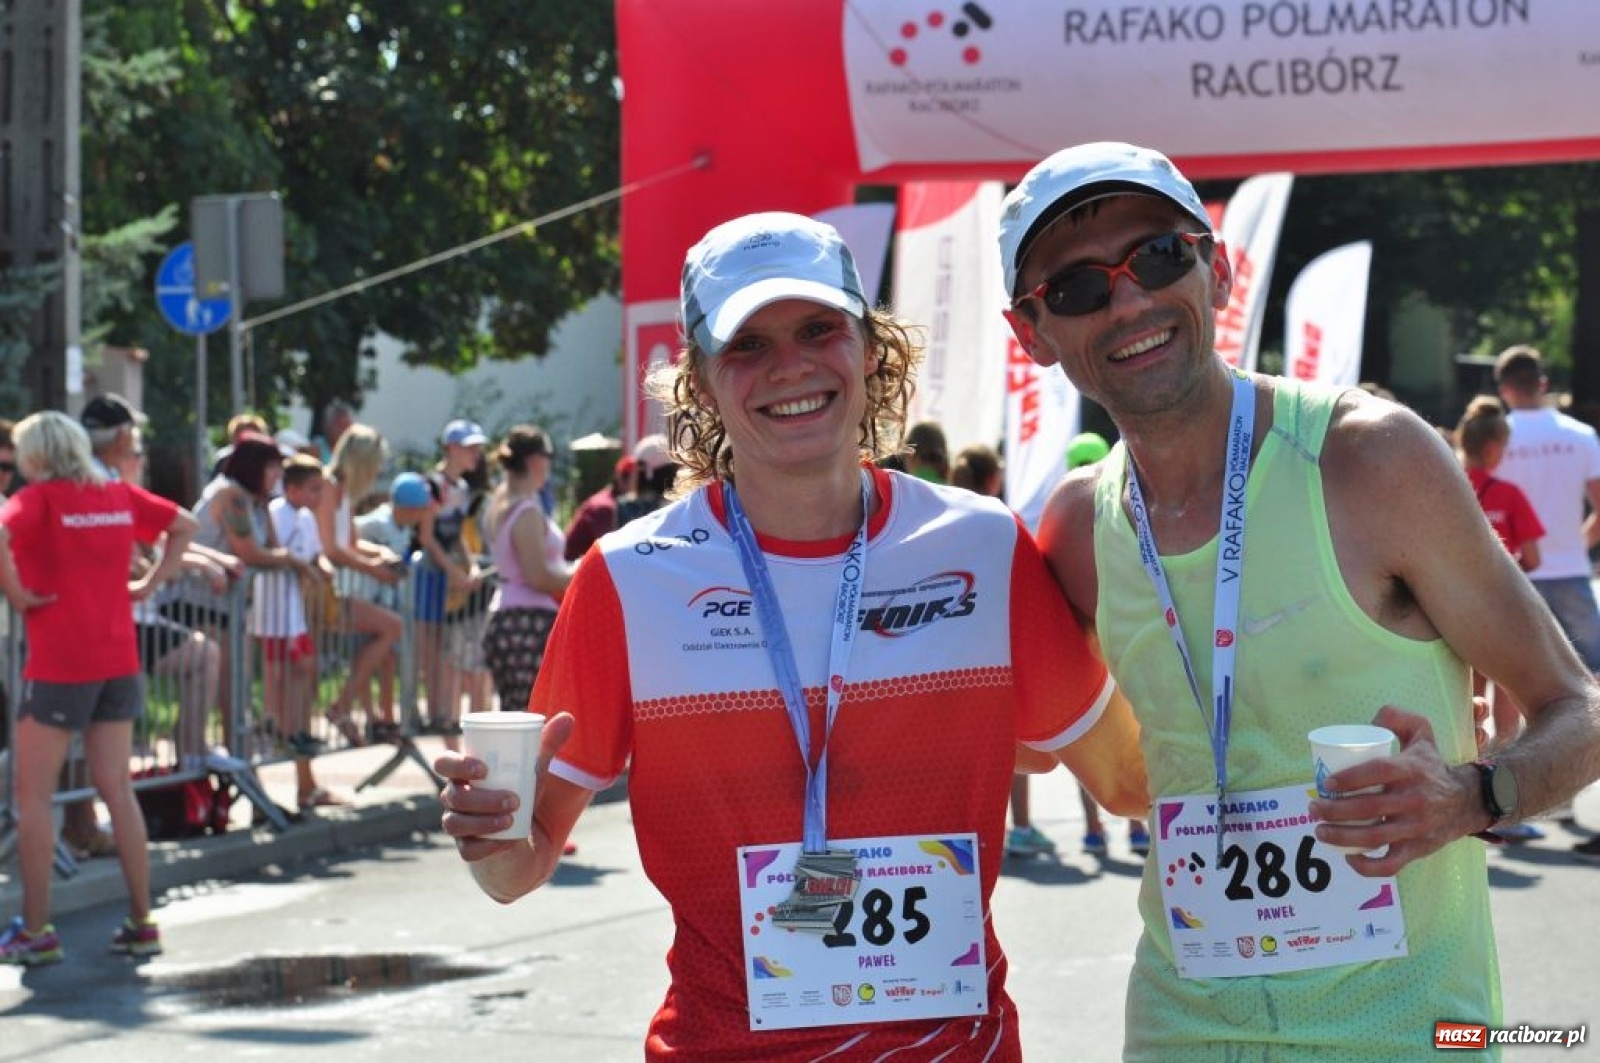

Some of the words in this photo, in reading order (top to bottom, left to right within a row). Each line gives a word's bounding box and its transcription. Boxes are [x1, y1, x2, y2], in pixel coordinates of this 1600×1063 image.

[1064, 4, 1224, 44] RAFAKO
[1191, 47, 1404, 98] RACIBÓRZ
[1223, 473, 1246, 561] RAFAKO
[1221, 567, 1239, 583] V
[703, 601, 752, 618] PGE
[710, 627, 732, 637] GIEK
[1206, 804, 1215, 816] V
[1175, 822, 1253, 836] PÓŁMAATON
[1255, 813, 1321, 831] RACIBÓR
[867, 865, 933, 878] RACIBÓRZ
[1221, 836, 1331, 900] 286
[823, 886, 931, 948] 285
[1257, 904, 1296, 921] PAWEŁ
[858, 953, 896, 969] PAWEŁ
